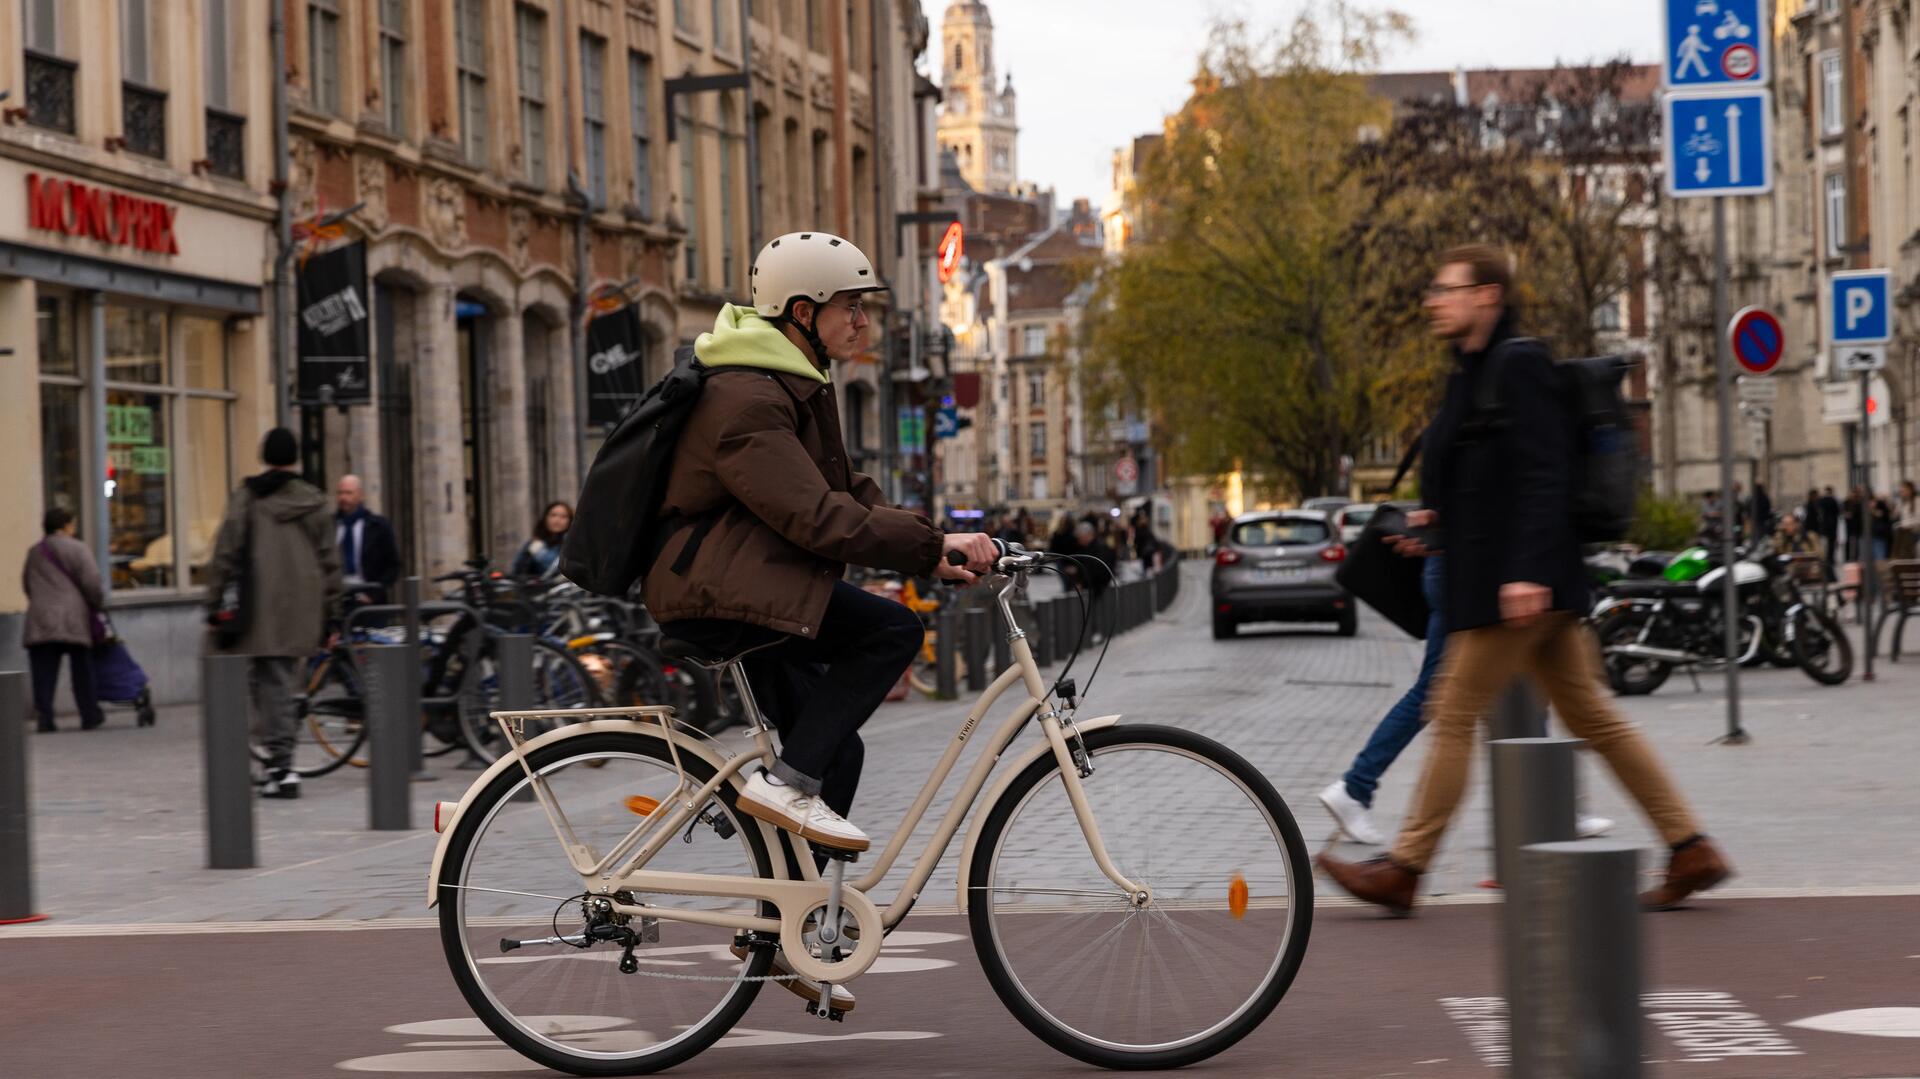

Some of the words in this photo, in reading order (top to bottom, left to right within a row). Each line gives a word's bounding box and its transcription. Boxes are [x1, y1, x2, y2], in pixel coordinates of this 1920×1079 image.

[27, 173, 179, 255] MONOPRIX
[1846, 287, 1873, 330] P
[958, 717, 975, 741] BTWIN
